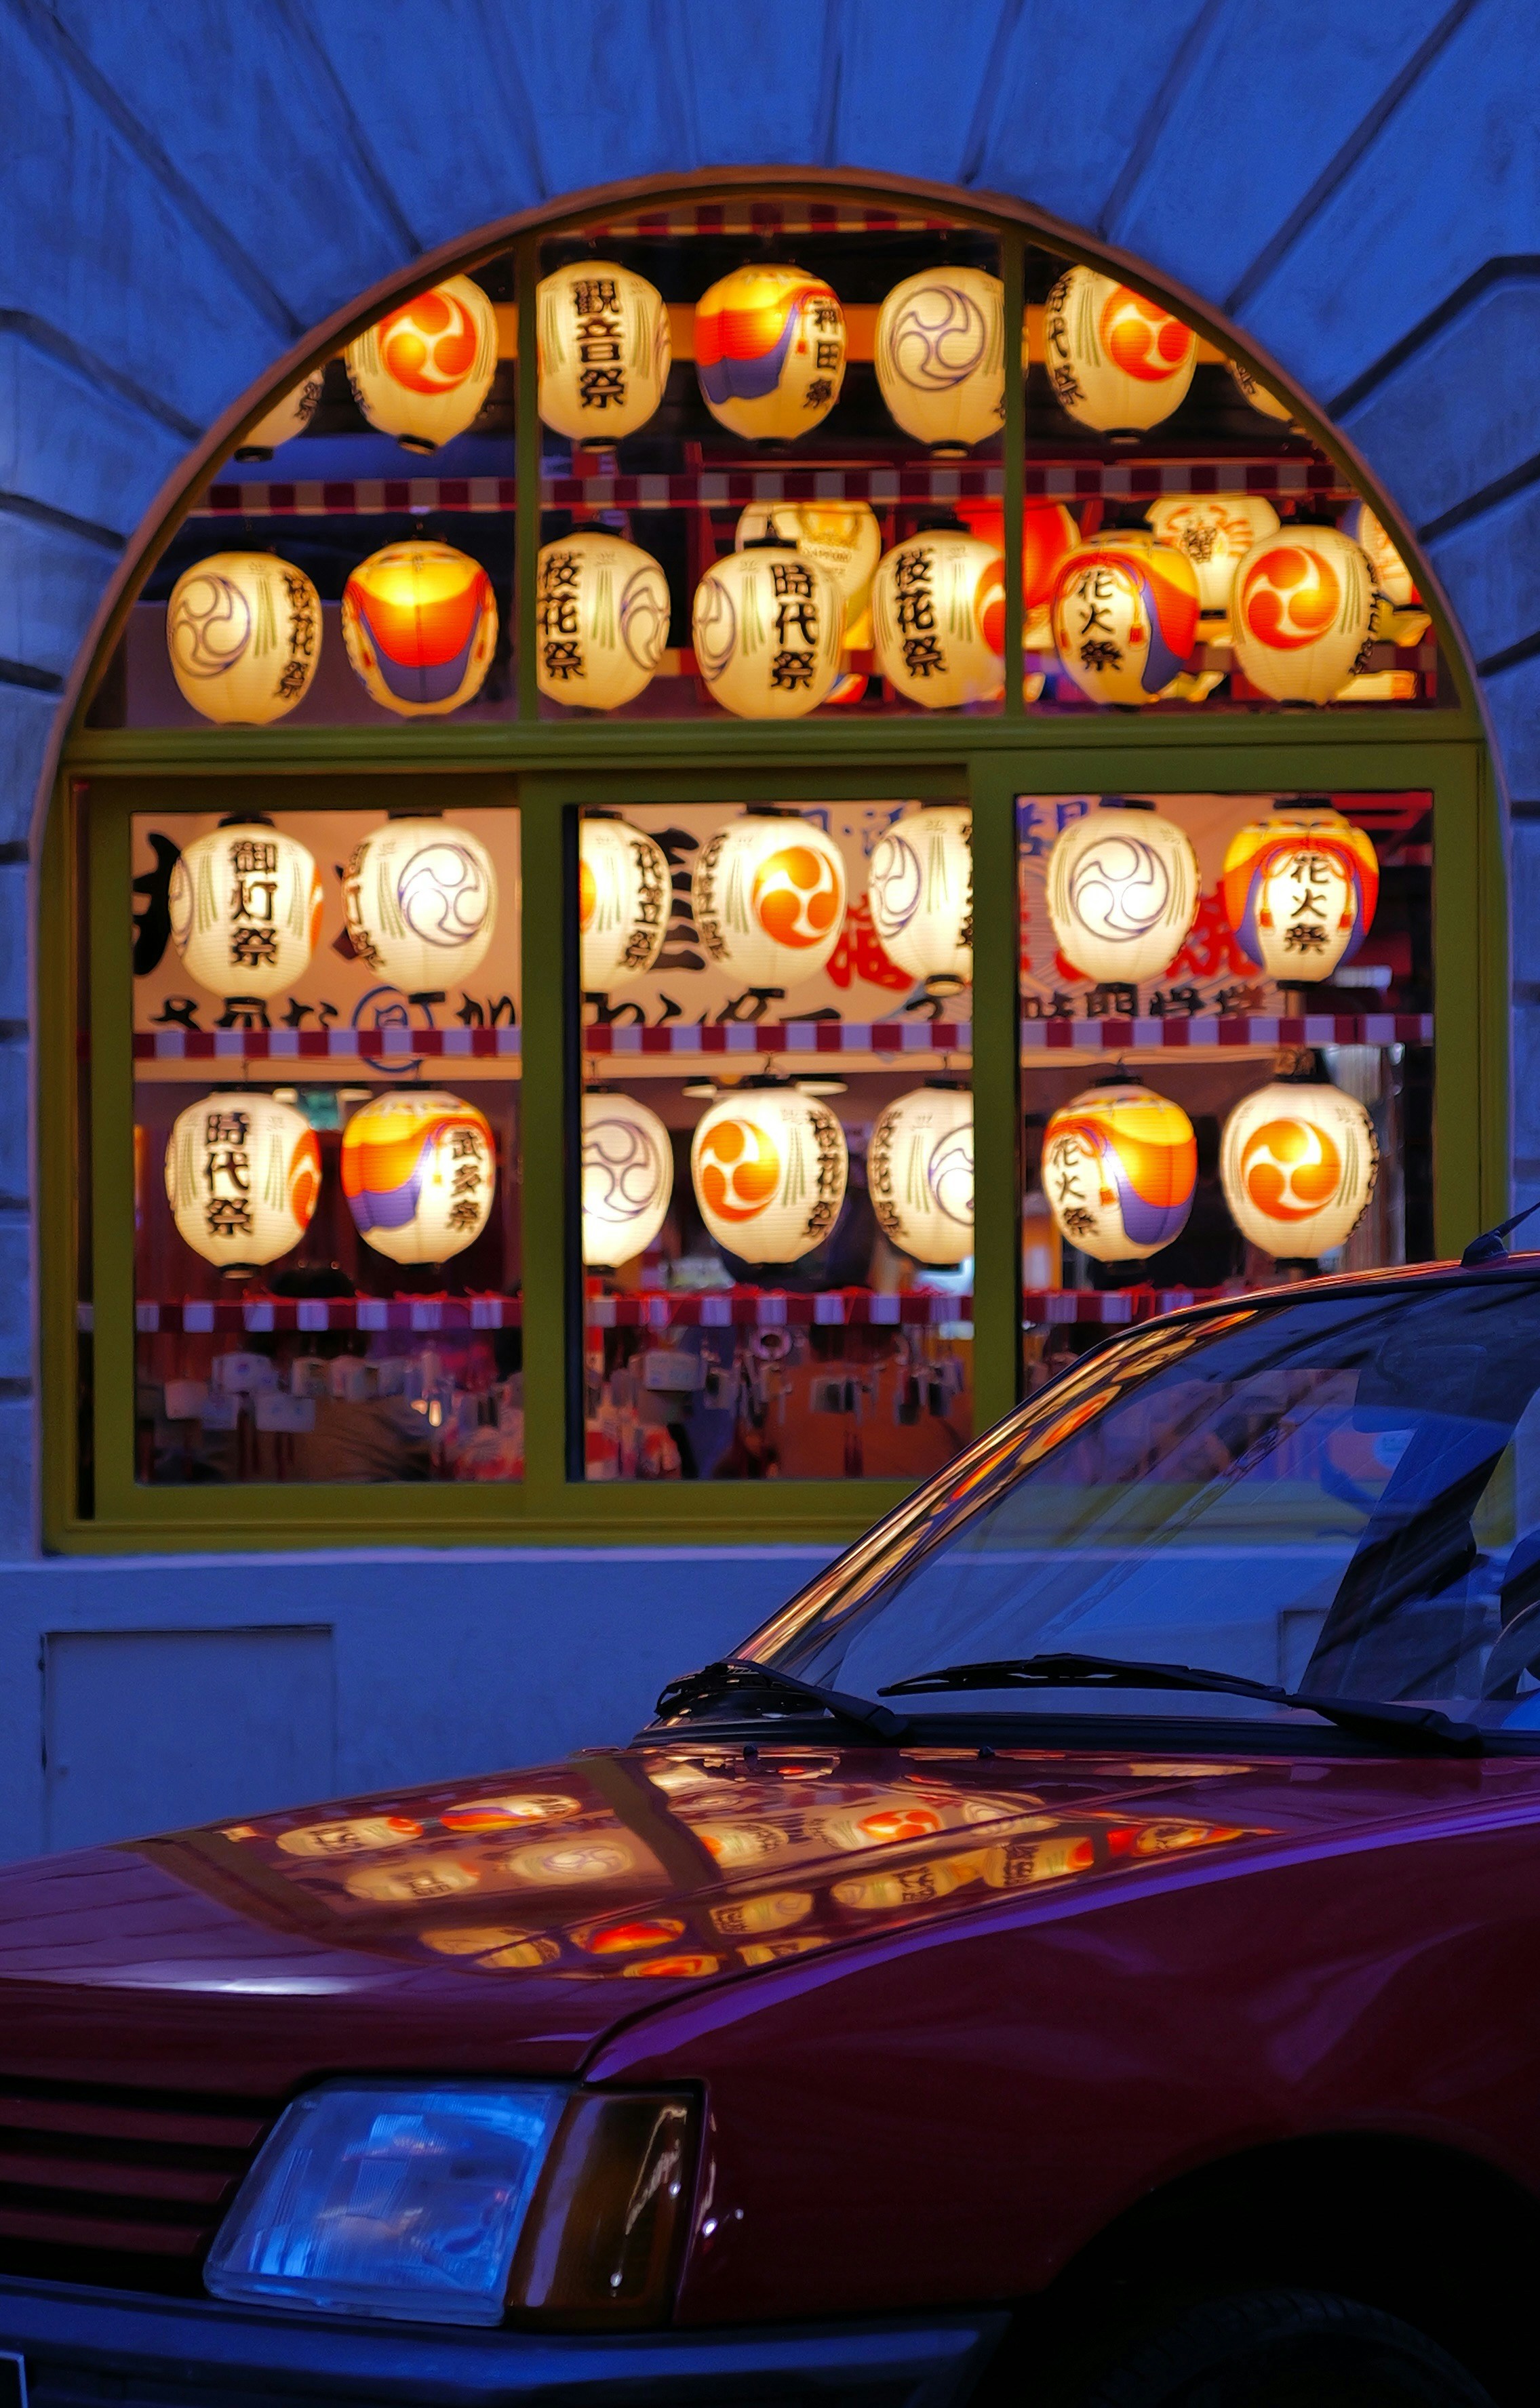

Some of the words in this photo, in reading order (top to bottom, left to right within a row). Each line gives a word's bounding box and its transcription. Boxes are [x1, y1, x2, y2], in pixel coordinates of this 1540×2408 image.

[771, 563, 818, 690] 時代祭
[1080, 569, 1122, 671] 花火祭
[1284, 855, 1330, 955] 花火祭
[207, 1112, 253, 1236] 時代祭
[1052, 1138, 1100, 1237] 花火祭
